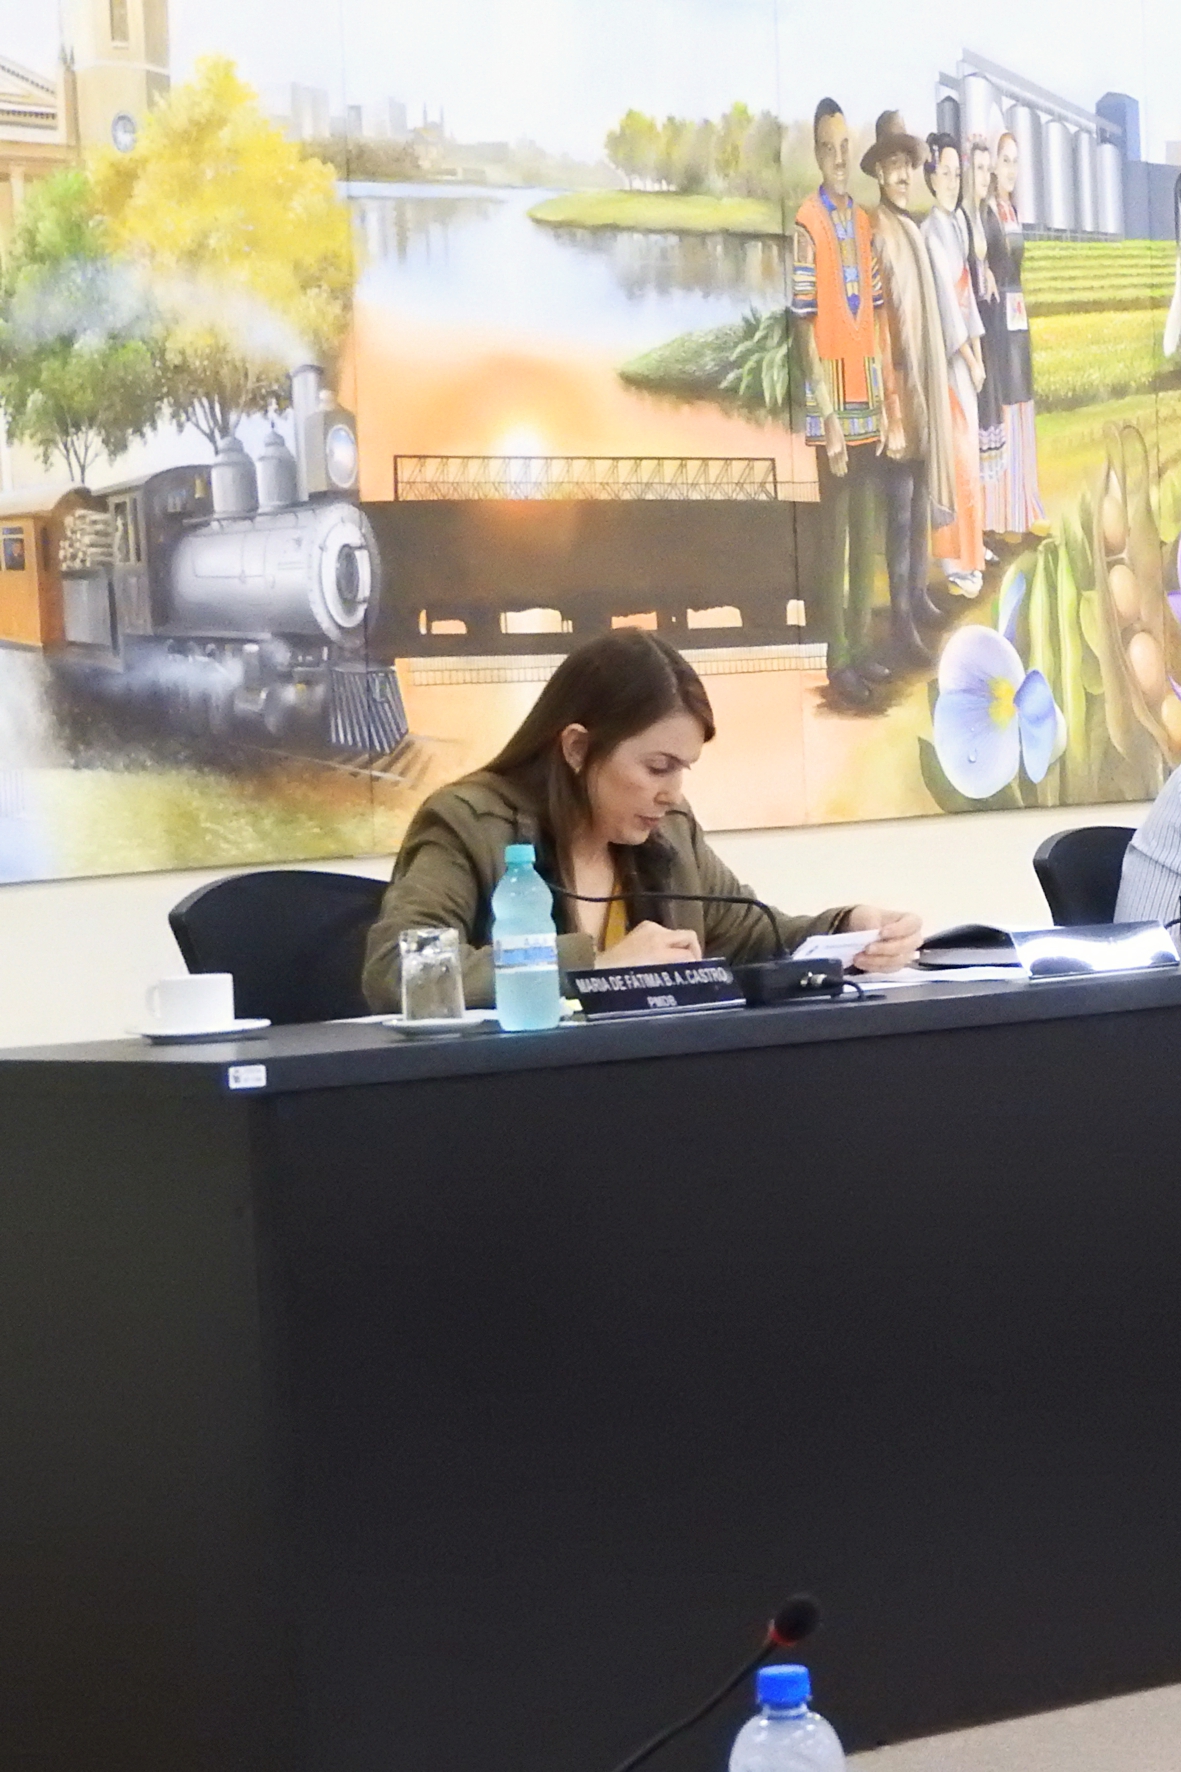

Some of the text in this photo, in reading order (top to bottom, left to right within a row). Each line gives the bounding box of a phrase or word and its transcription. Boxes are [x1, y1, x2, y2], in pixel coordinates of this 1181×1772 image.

[575, 976, 611, 993] MARIA
[609, 975, 626, 991] DE
[624, 971, 663, 988] FÁTIMA
[686, 966, 727, 984] CASTRO
